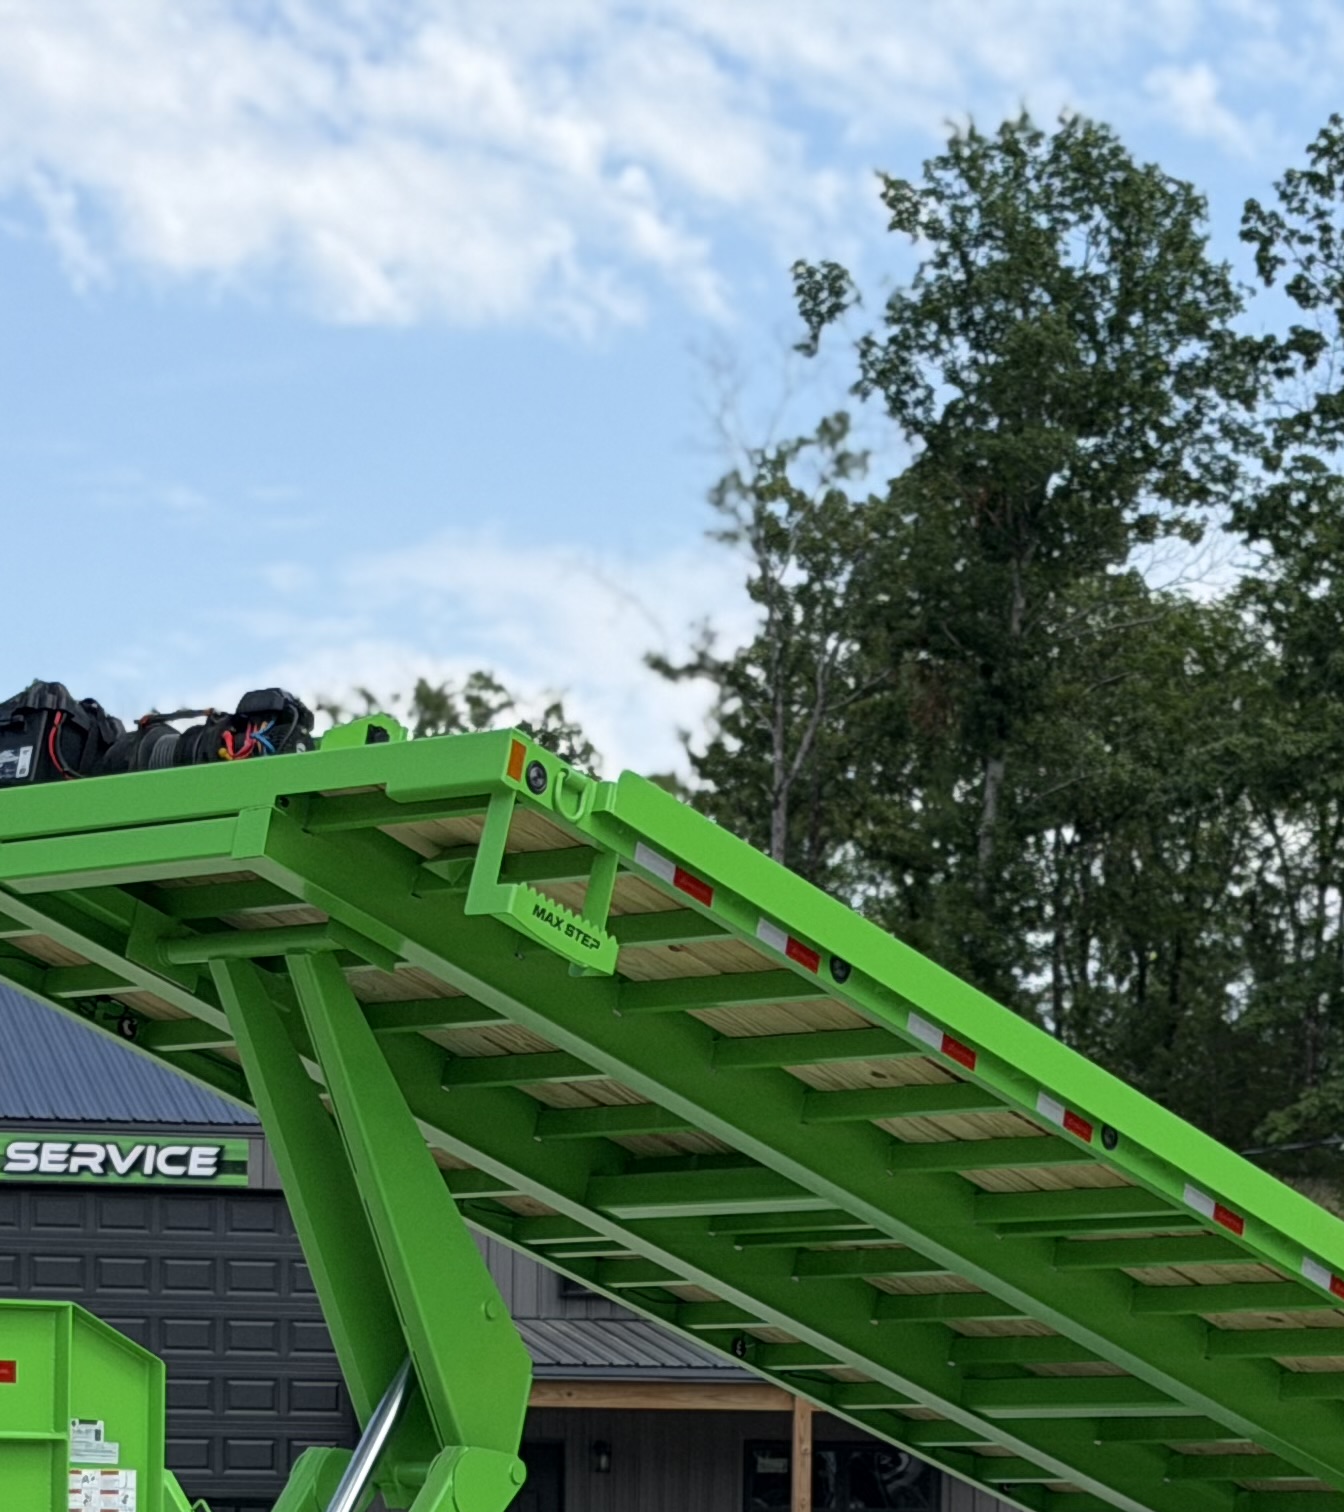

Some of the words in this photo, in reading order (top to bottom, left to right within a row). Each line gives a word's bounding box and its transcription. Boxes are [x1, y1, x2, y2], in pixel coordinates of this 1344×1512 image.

[532, 904, 564, 931] MAX
[564, 923, 601, 950] STEP
[3, 1141, 221, 1176] SERVICE
